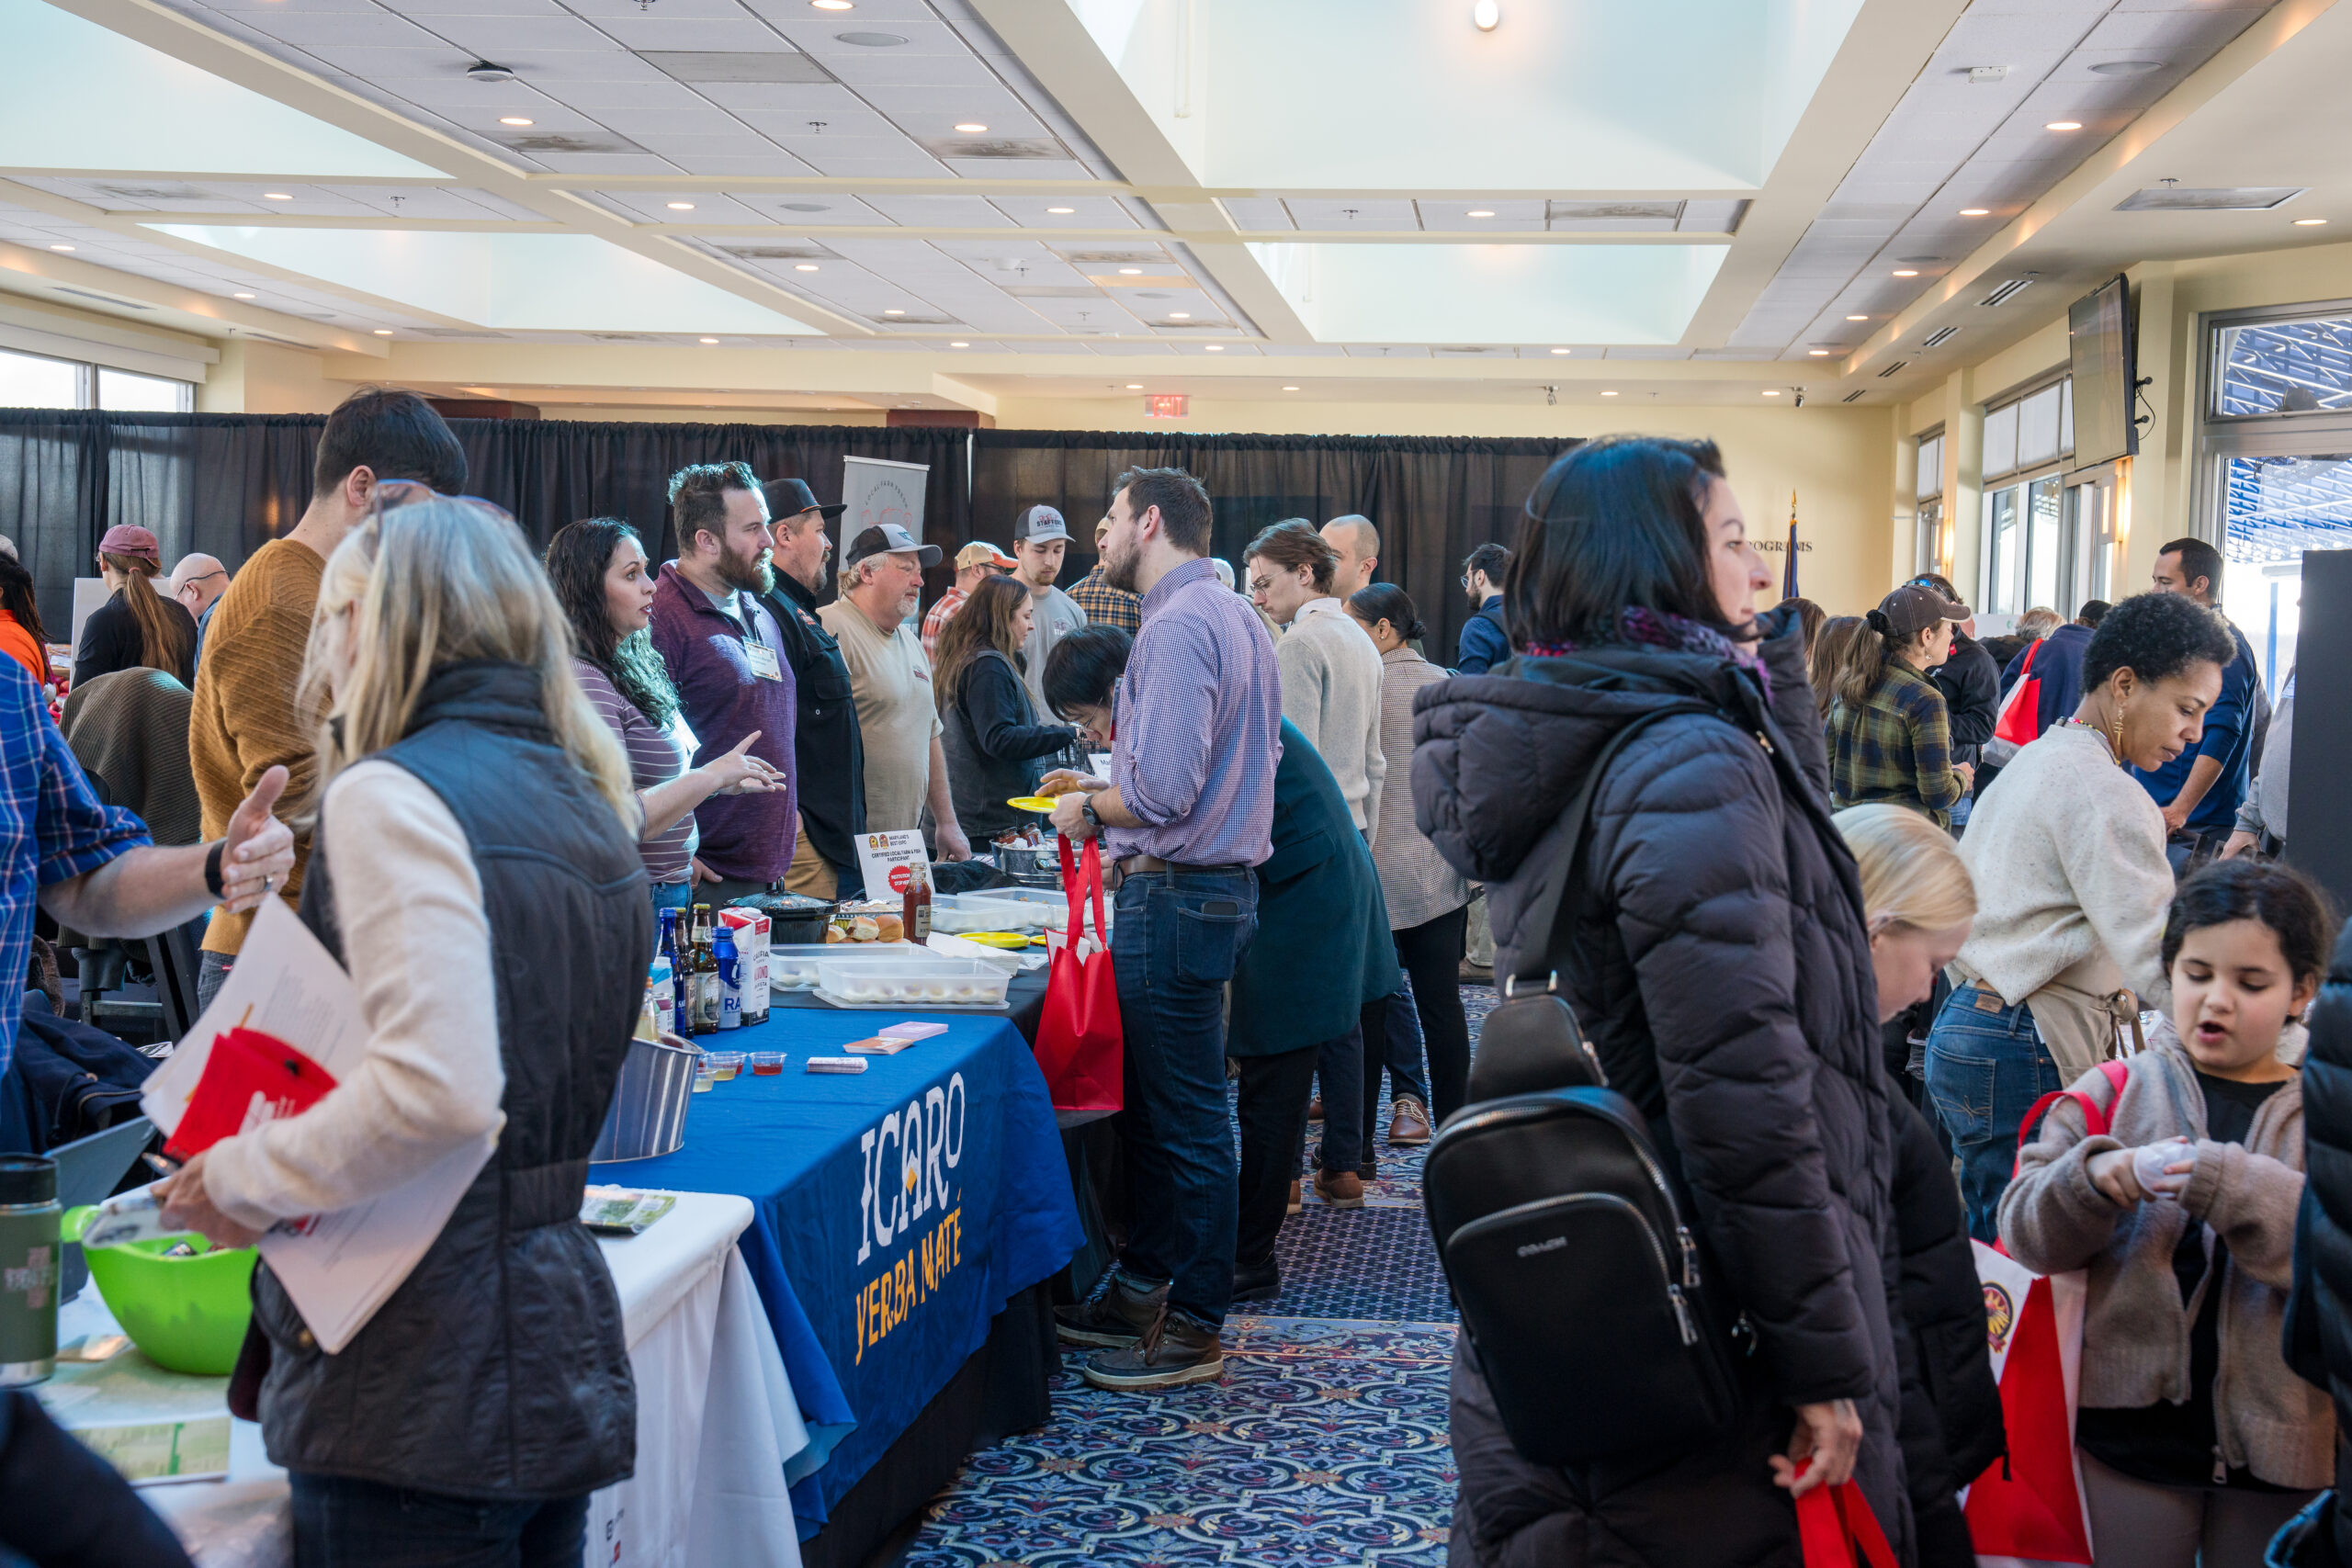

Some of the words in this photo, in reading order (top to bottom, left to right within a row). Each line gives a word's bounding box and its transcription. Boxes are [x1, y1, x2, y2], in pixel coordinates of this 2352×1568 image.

[1153, 395, 1183, 417] EXIT
[857, 1071, 965, 1266] ICARO
[855, 1248, 917, 1367] YERBA
